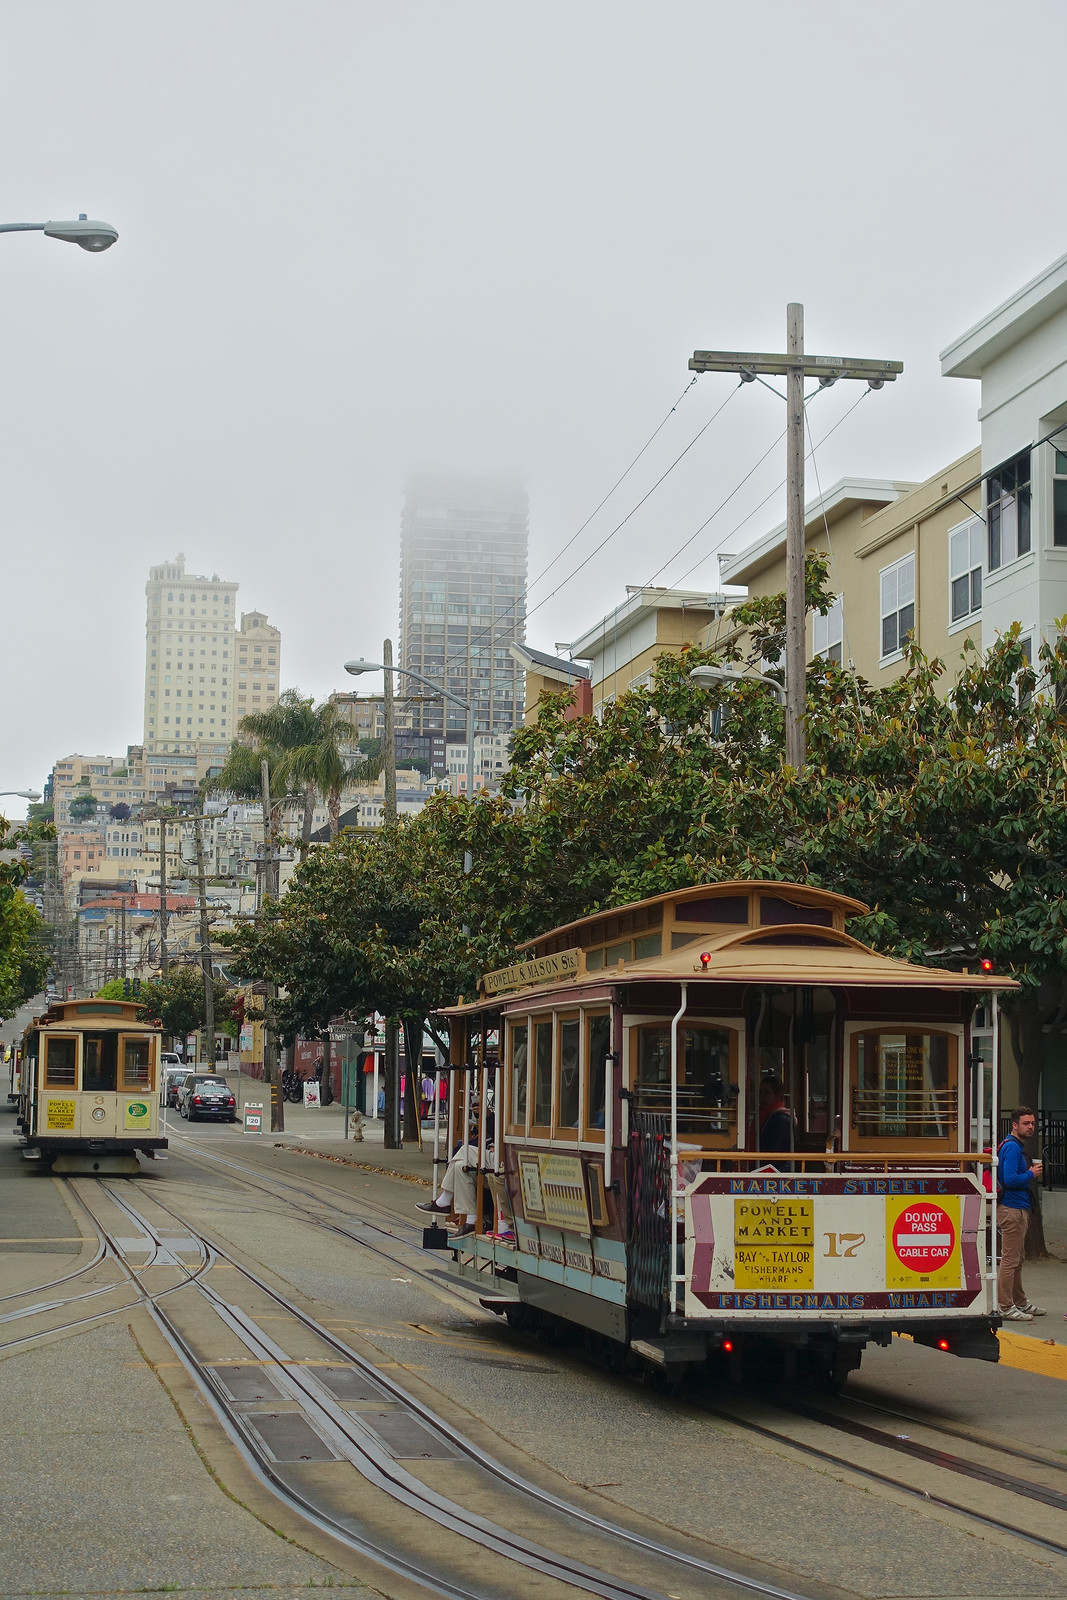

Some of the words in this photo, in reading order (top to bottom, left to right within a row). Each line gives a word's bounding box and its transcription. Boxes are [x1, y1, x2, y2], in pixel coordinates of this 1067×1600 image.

[488, 971, 518, 988] POWELL
[520, 968, 526, 980] &
[528, 958, 558, 978] MASON
[94, 1096, 104, 1104] 3
[730, 1180, 822, 1194] MARKET
[844, 1180, 929, 1194] STREET
[740, 1206, 809, 1216] POWELL
[905, 1213, 920, 1222] DO
[922, 1213, 943, 1222] NOT
[738, 1227, 810, 1236] MARKET
[912, 1223, 937, 1232] PASS
[528, 1239, 536, 1252] SAN
[823, 1232, 866, 1257] 17
[739, 1252, 757, 1262] BAY
[772, 1252, 810, 1262] TAYLOR
[900, 1248, 928, 1257] CABLE
[931, 1248, 949, 1256] CAR
[719, 1294, 865, 1309] FISHERMANS
[888, 1293, 958, 1308] WHARF
